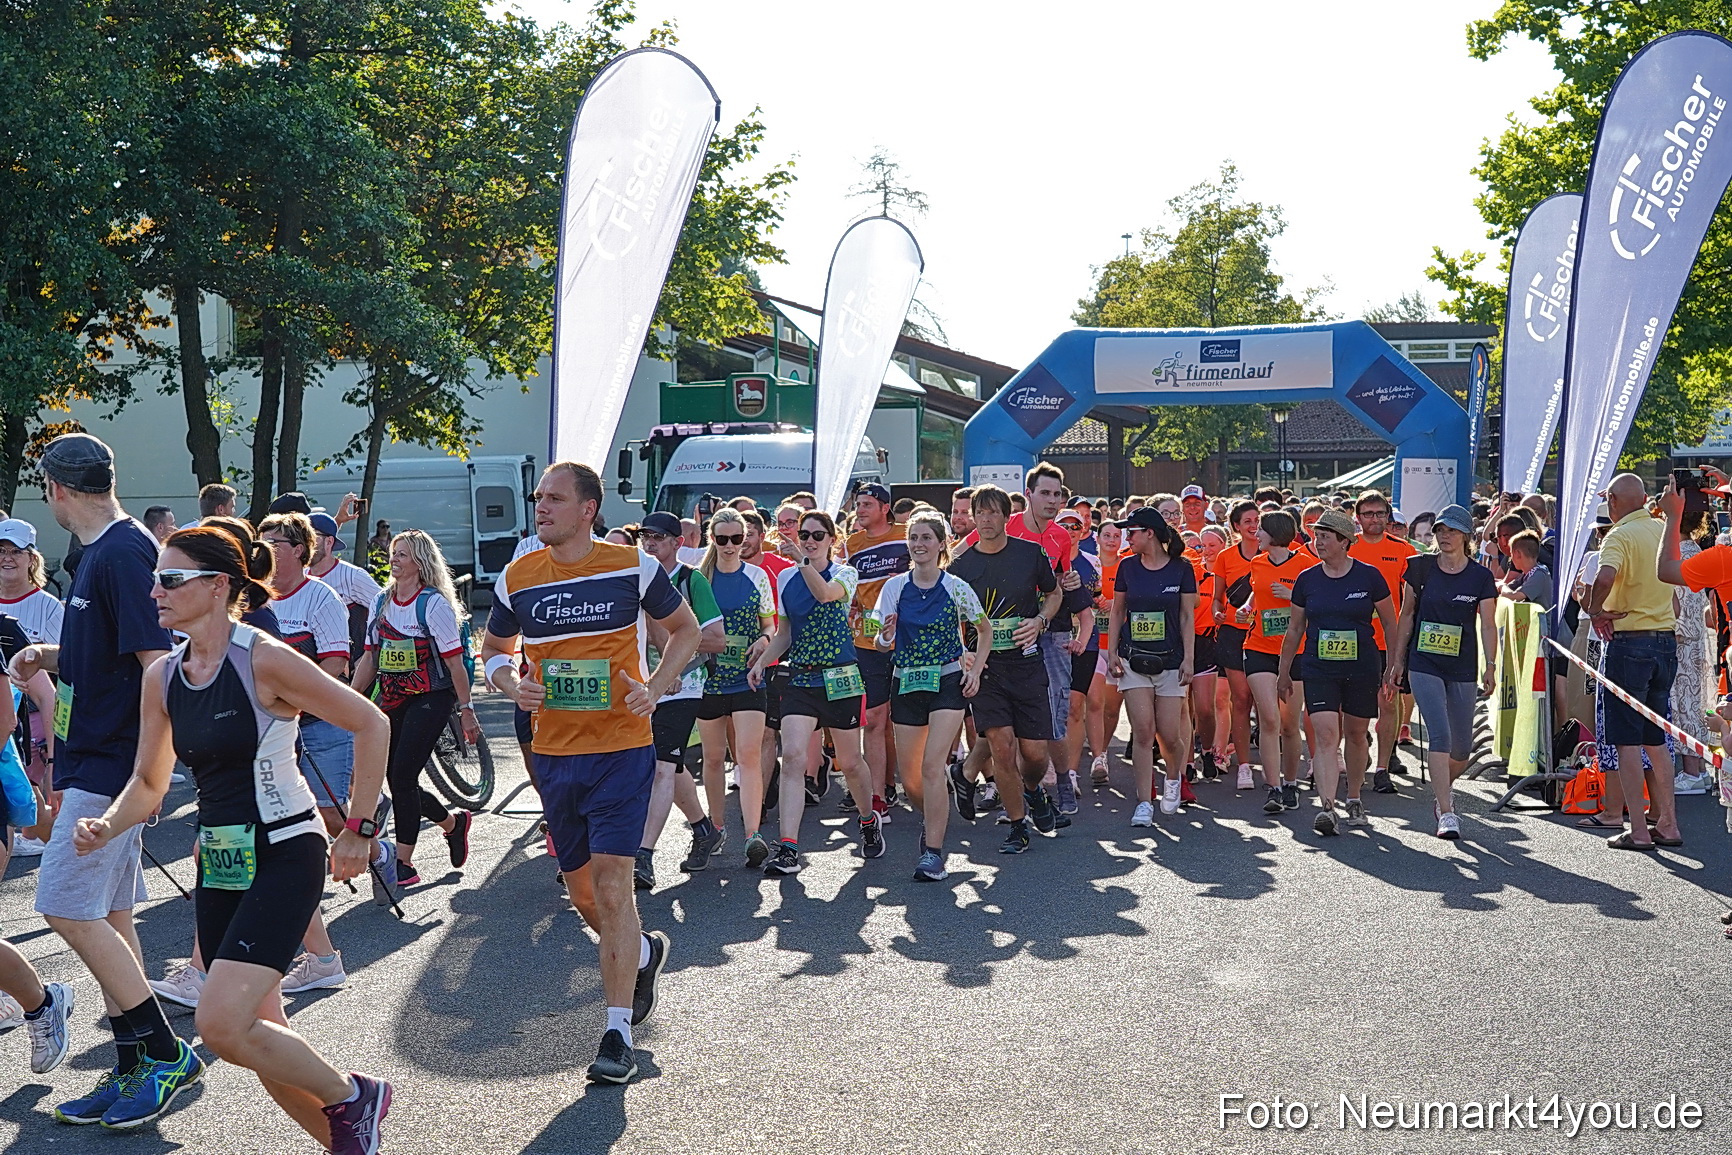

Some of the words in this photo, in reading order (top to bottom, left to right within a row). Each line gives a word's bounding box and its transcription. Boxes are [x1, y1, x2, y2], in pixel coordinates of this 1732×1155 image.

[1631, 74, 1712, 230] Fischer
[1666, 95, 1727, 222] AUTOMOBILE
[1186, 361, 1274, 380] firmenlauf
[1361, 388, 1375, 398] und
[1376, 386, 1388, 394] das
[1398, 391, 1415, 399] mit!
[1016, 394, 1065, 405] Fischer
[674, 461, 715, 472] abavent
[861, 557, 899, 570] Fischer
[866, 564, 897, 574] AUTOMOBILE
[545, 601, 615, 619] Fischer
[553, 613, 611, 626] AUTOMOBILE
[1136, 622, 1156, 632] 887
[992, 629, 1013, 641] 660
[1428, 632, 1451, 646] 873
[1327, 640, 1348, 651] 872
[385, 650, 406, 662] 156
[835, 674, 857, 689] 683
[907, 670, 929, 683] 689
[546, 681, 554, 700] RUN
[553, 676, 599, 694] 1819
[600, 679, 608, 703] 2022
[214, 710, 234, 720] CRAFT
[259, 758, 285, 808] CRAFT
[206, 848, 246, 870] 1304
